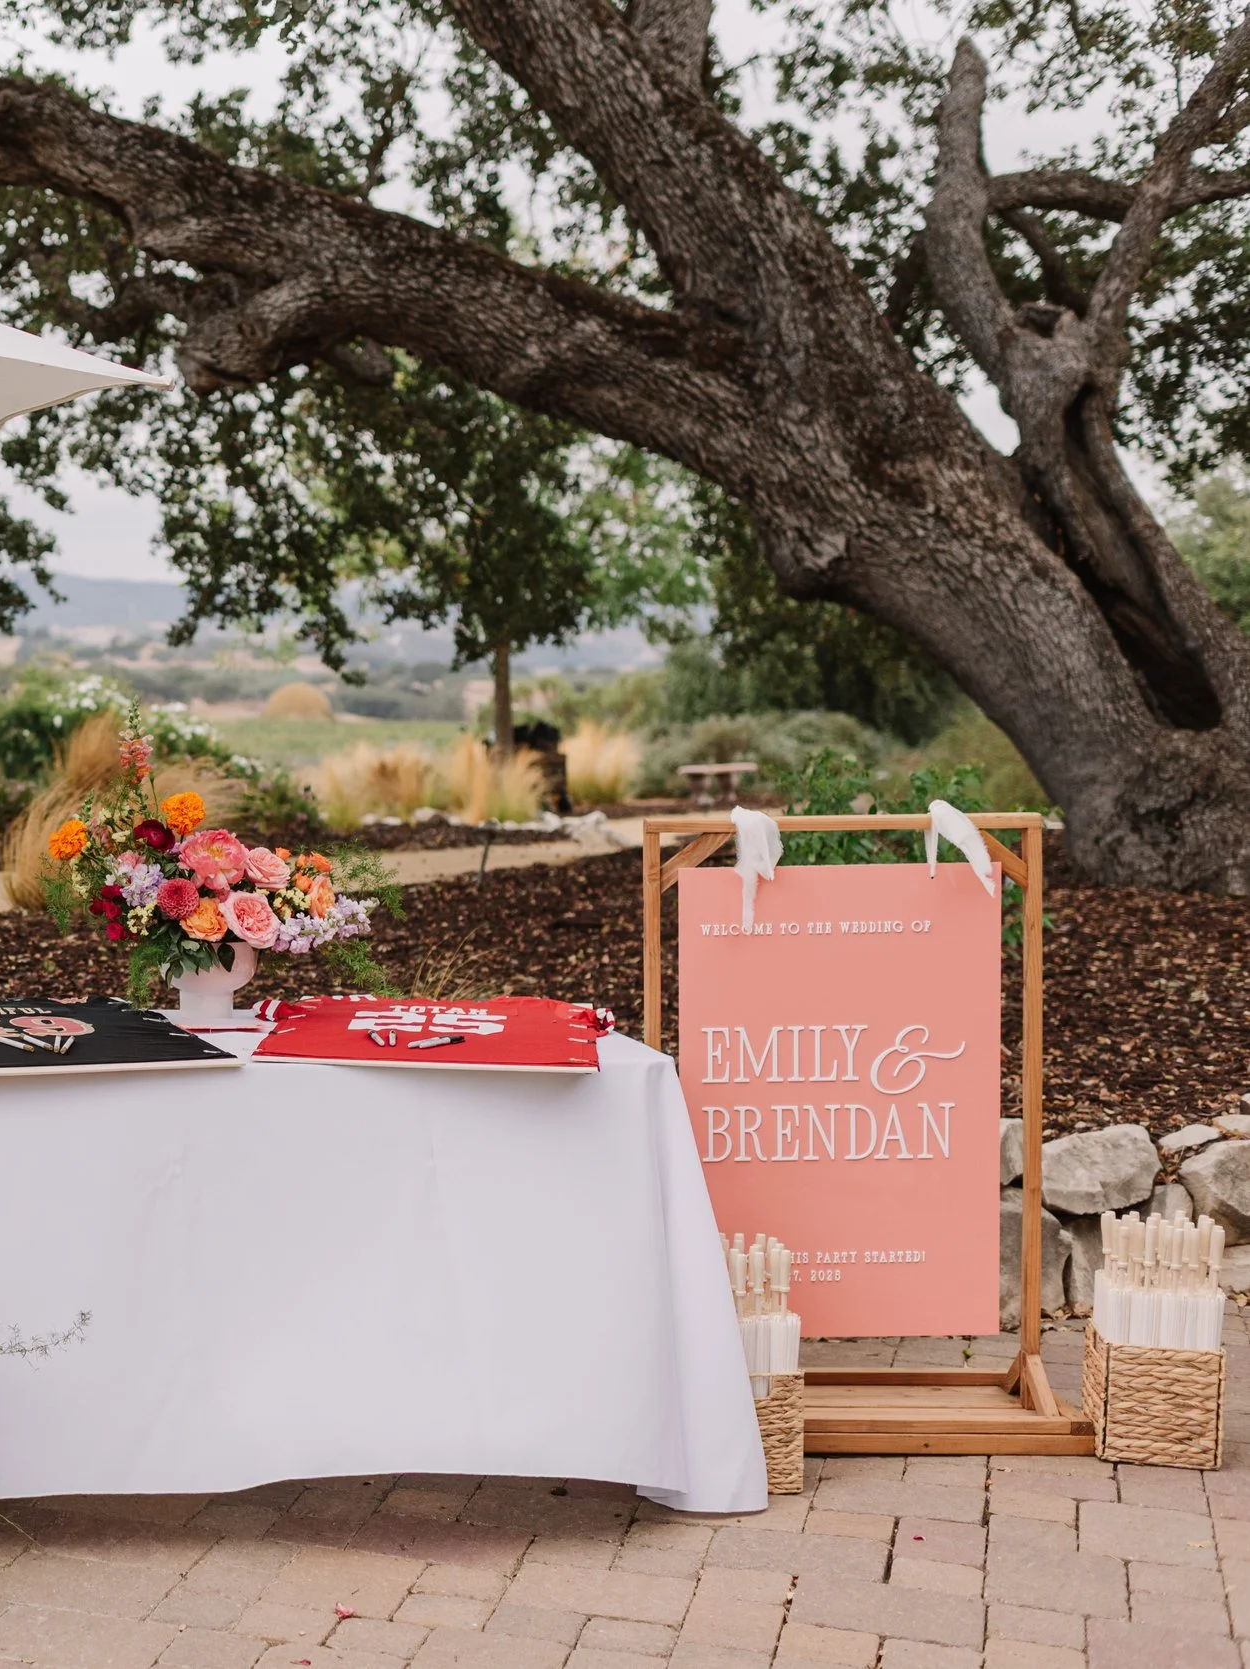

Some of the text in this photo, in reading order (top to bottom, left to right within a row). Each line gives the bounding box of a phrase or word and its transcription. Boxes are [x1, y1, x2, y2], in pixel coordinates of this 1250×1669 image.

[701, 920, 931, 936] WELCOME TO THE WEDDING OF
[347, 1010, 508, 1035] 25
[701, 1024, 967, 1096] EMILY &
[701, 1102, 956, 1163] BRENDAN
[815, 1251, 857, 1264] PARTY
[864, 1250, 927, 1263] STARTED!
